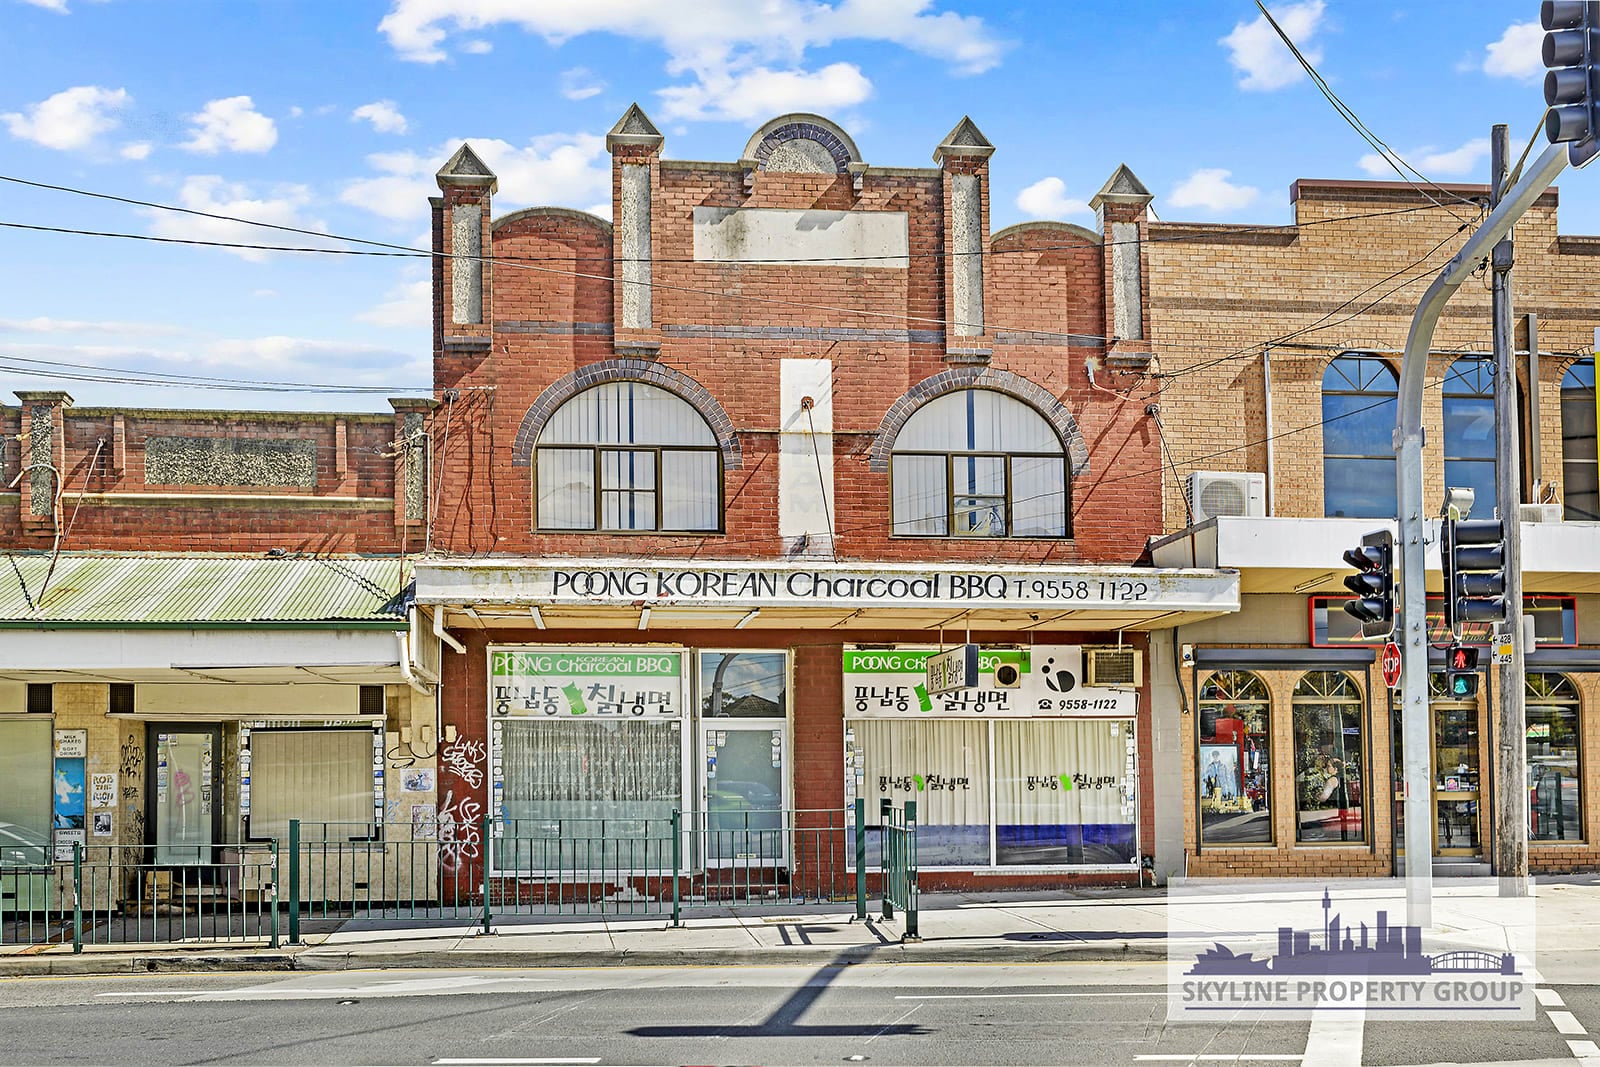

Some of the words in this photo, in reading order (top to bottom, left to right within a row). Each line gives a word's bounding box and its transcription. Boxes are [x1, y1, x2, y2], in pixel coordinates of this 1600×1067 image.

[553, 571, 648, 596] POONG
[656, 571, 777, 597] KOREAN
[787, 572, 940, 599] Charcoal
[950, 574, 1007, 600] BBQ
[1099, 581, 1148, 601] 1122
[1499, 635, 1511, 644] 428
[495, 656, 552, 673] POONG
[556, 658, 632, 673] Charcoal
[636, 657, 673, 673] BBQ
[852, 656, 901, 670] POONG
[1384, 657, 1399, 673] STOP
[1499, 655, 1512, 664] 445
[495, 686, 559, 715] 풍납동
[587, 683, 674, 716] 칡냉면
[855, 686, 910, 712] 풍납동
[1059, 699, 1117, 711] 9558-1122
[93, 775, 113, 784] ROB
[879, 775, 911, 792] 풍납동
[1027, 776, 1057, 791] 풍납동
